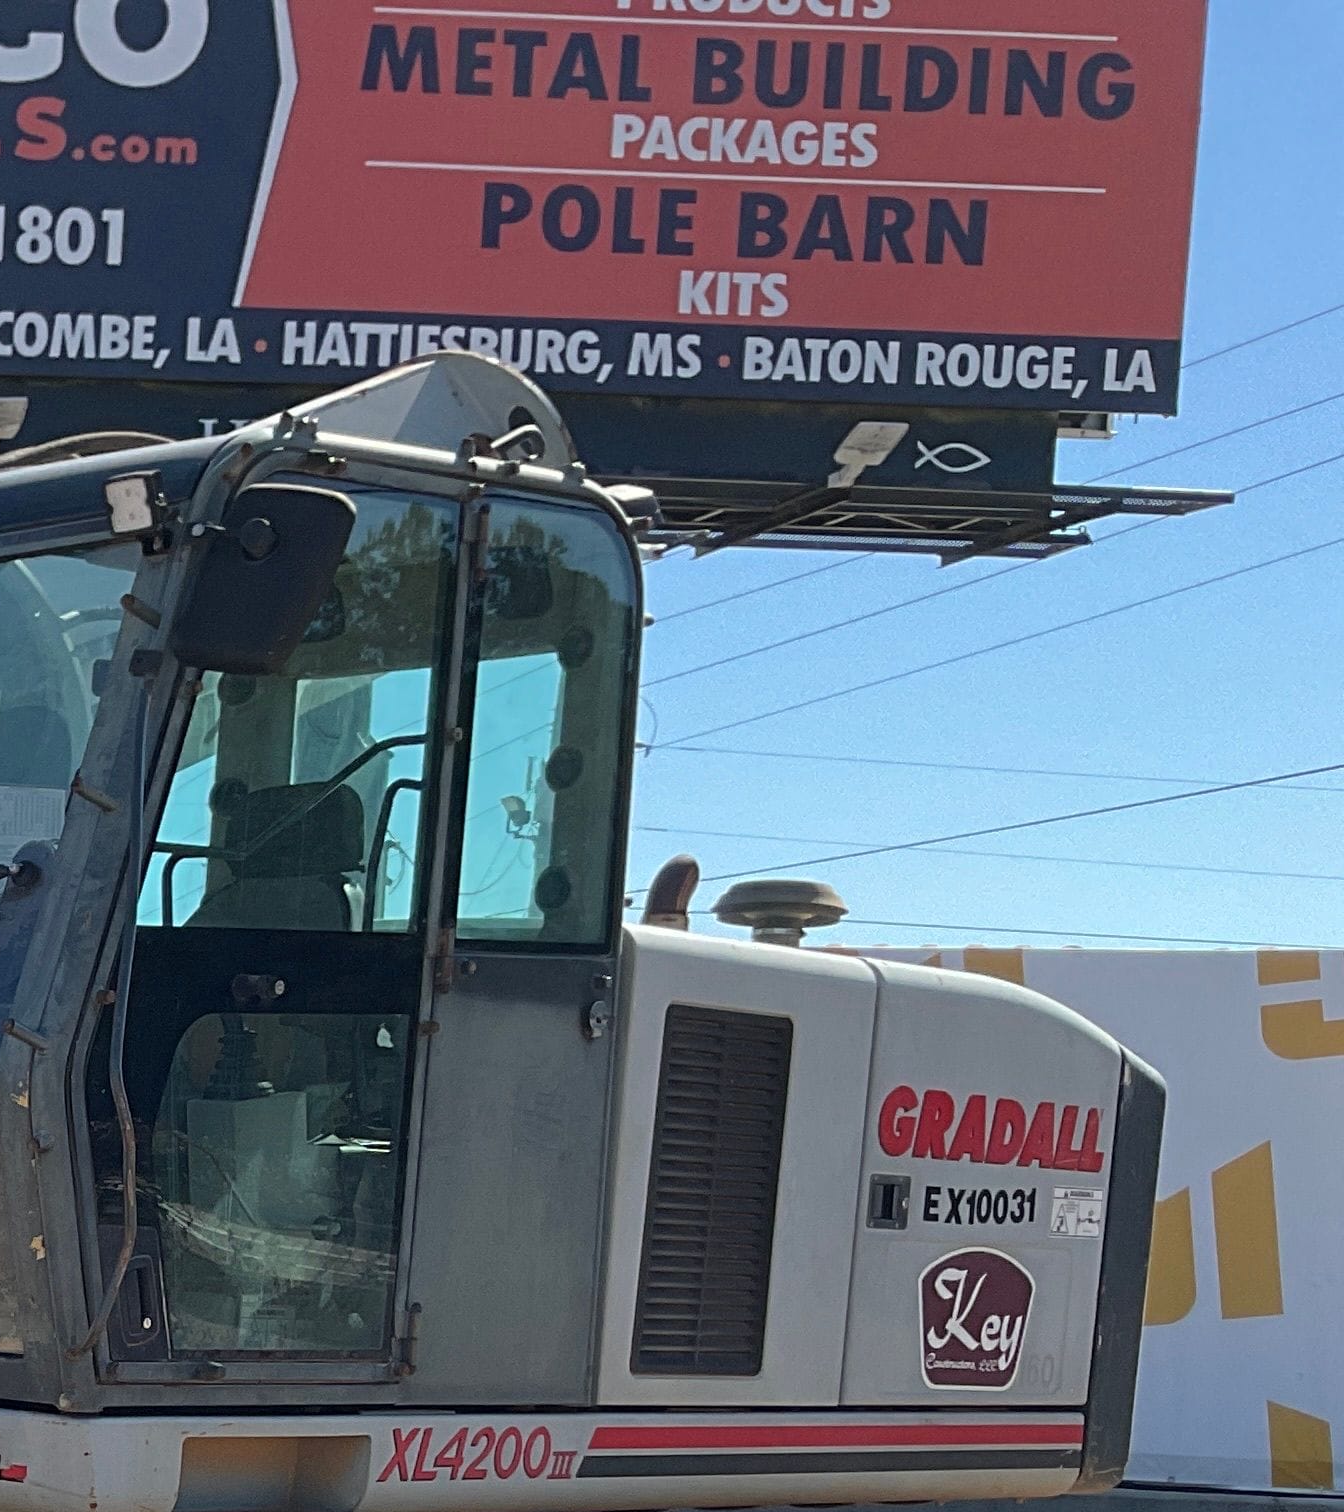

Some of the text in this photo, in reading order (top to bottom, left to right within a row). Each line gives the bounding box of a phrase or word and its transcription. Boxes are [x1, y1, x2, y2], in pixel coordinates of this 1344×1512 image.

[359, 23, 1137, 122] METAL BUILDING
[610, 113, 879, 168] PACKAGES
[479, 181, 990, 267] POLE BARN
[677, 269, 790, 317] KITS
[186, 317, 242, 364] LA
[626, 331, 702, 379] MS
[742, 336, 901, 385] BATON
[914, 342, 1089, 399] ROUGE,
[1102, 347, 1157, 394] LA
[878, 1085, 1105, 1173] GRADALL
[922, 1185, 1037, 1226] EX10031
[927, 1267, 1023, 1371] Key
